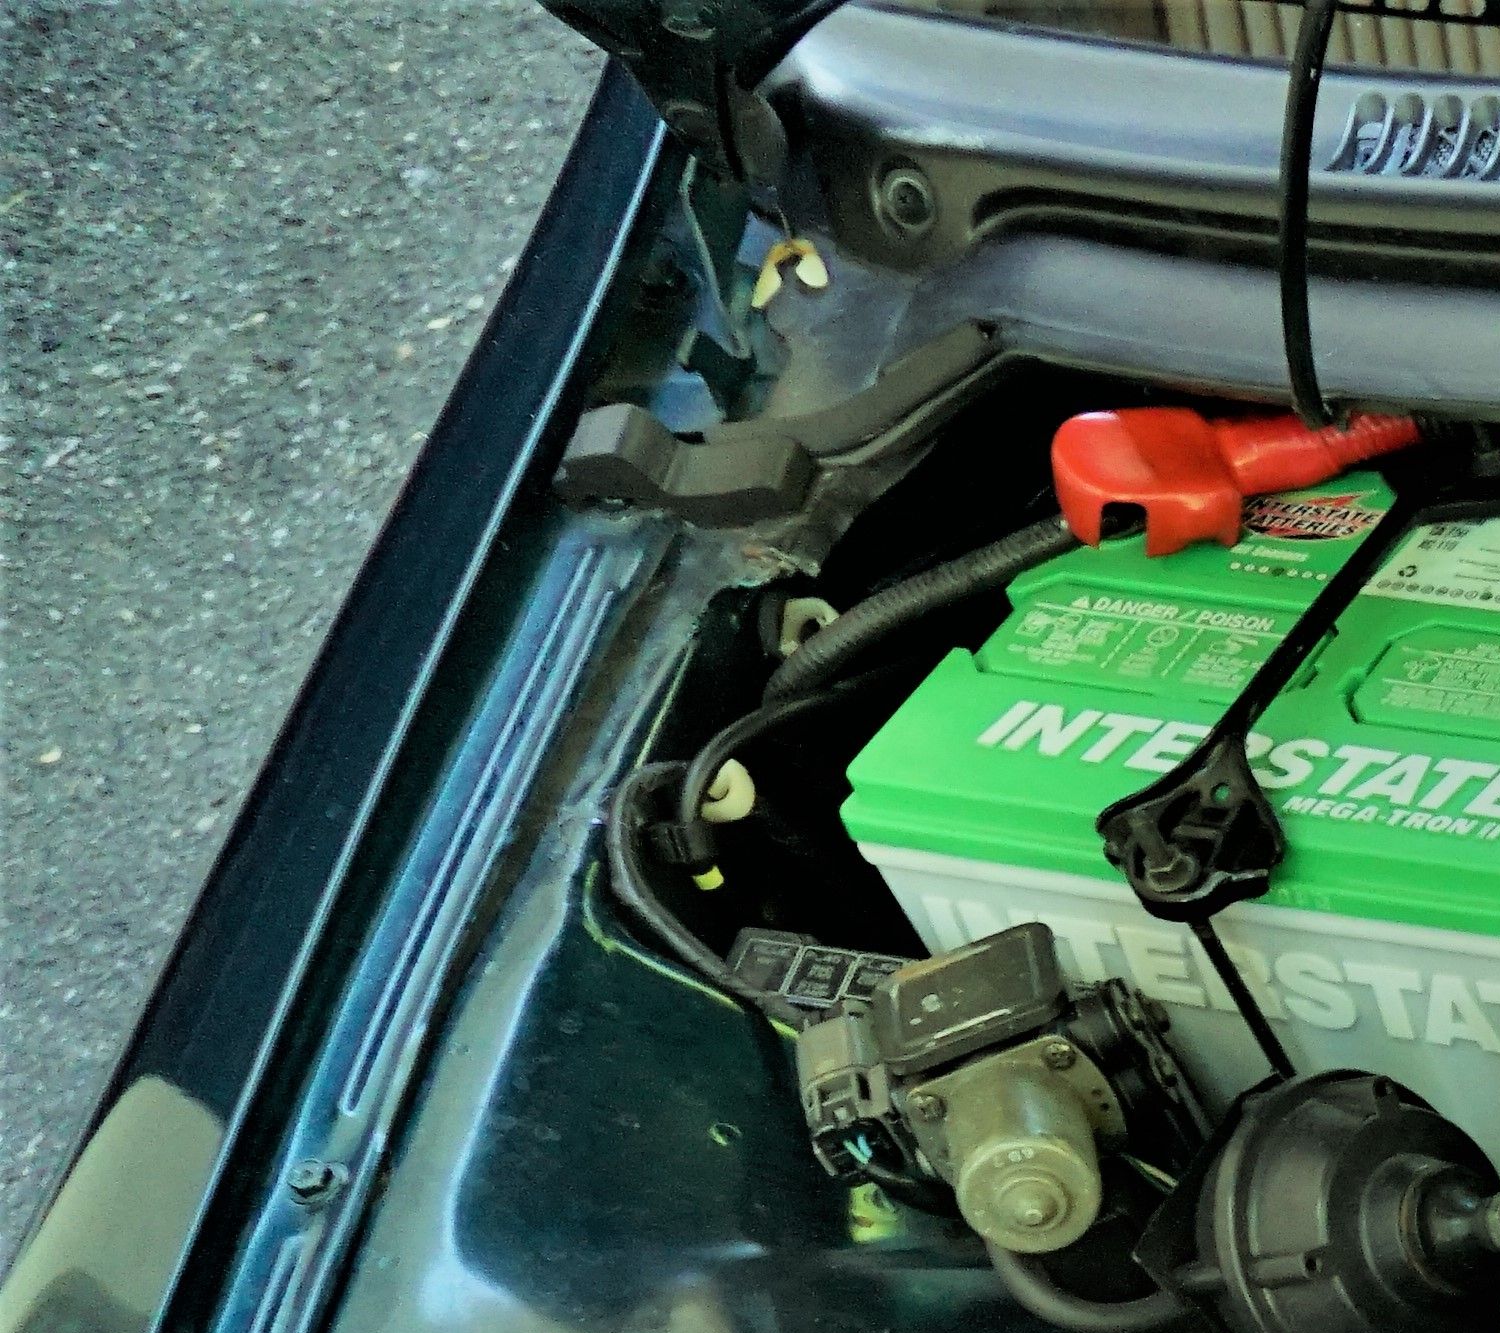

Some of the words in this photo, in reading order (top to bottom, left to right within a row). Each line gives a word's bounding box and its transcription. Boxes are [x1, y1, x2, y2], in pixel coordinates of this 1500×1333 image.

[1093, 597, 1179, 619] DANGER
[1197, 609, 1275, 632] POISON
[1284, 796, 1483, 834] MEGA-TRON
